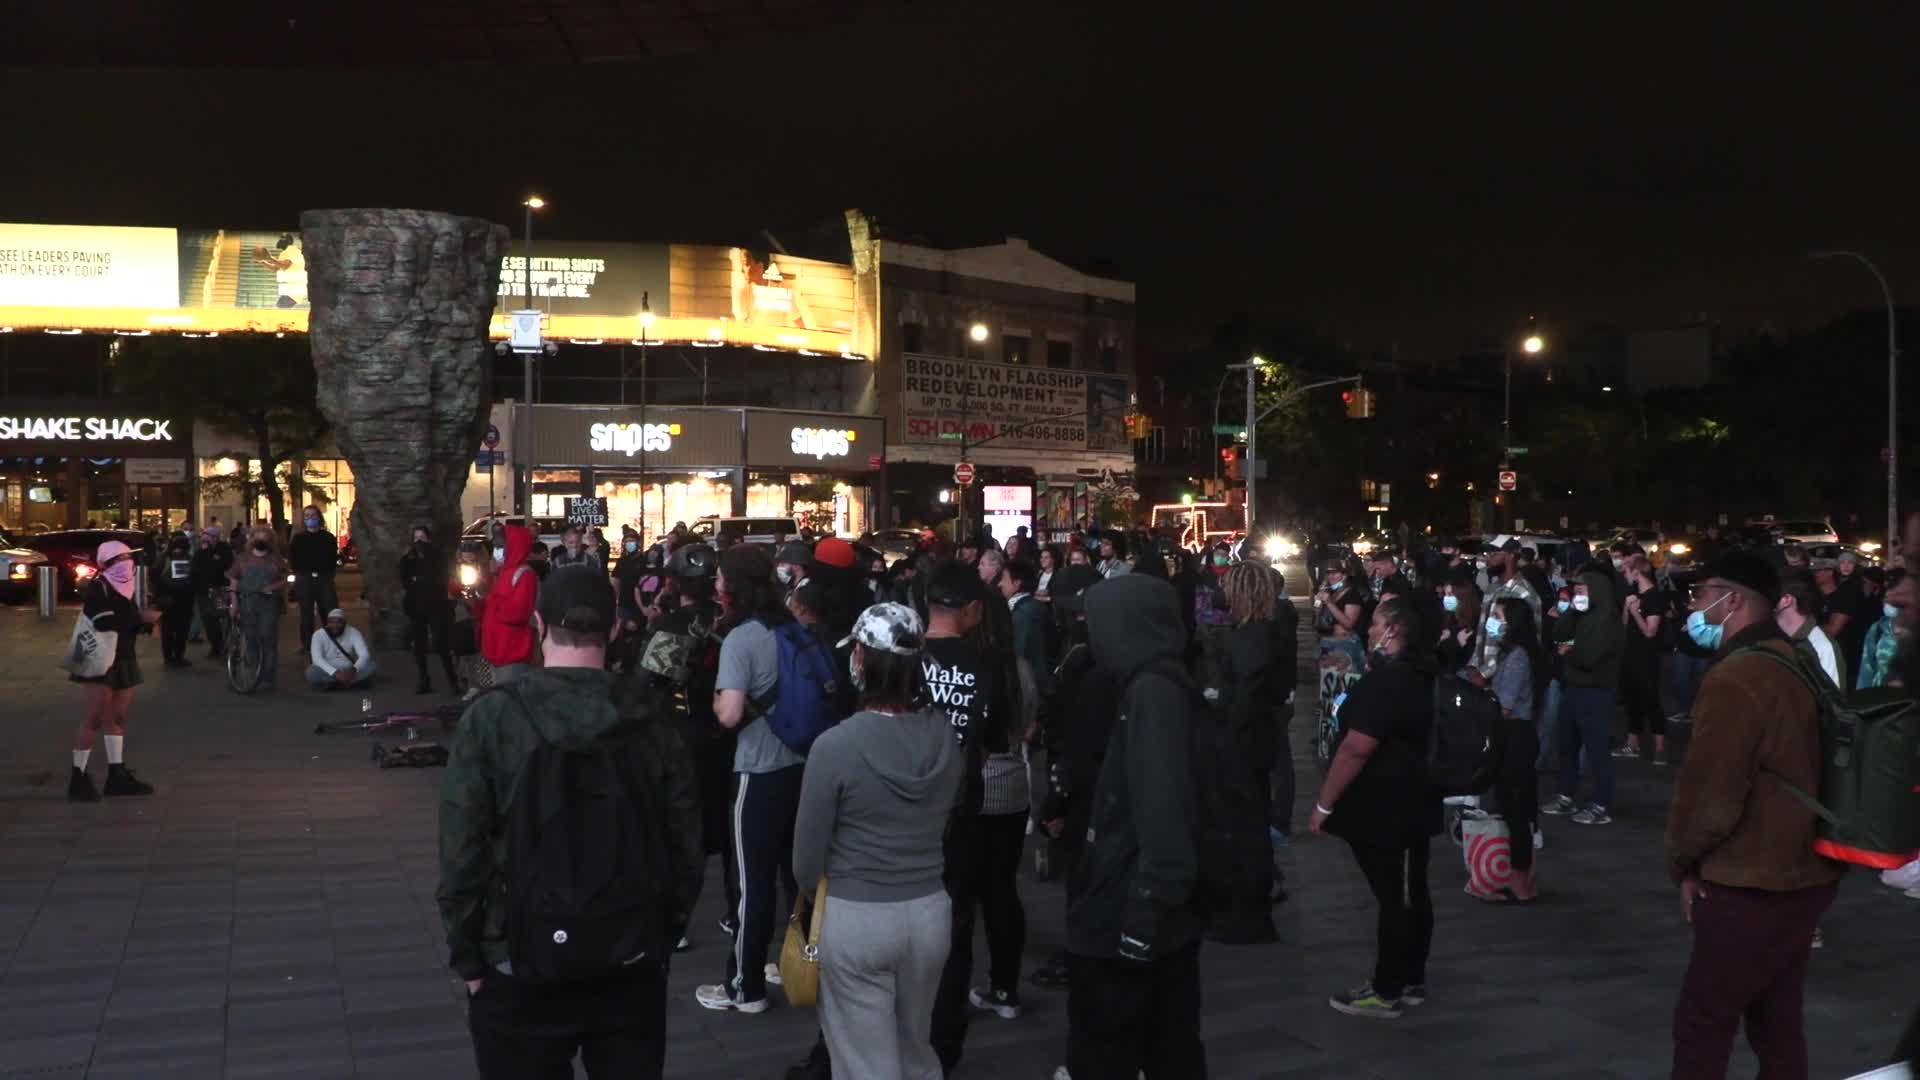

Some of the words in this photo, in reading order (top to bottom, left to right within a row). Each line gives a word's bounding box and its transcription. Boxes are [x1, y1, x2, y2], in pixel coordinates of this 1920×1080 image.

[0, 249, 18, 262] SEE
[22, 250, 70, 263] LEADERS
[73, 252, 111, 264] PAVING
[20, 264, 34, 276] ON
[38, 265, 71, 277] EVERY
[530, 257, 570, 271] HITTING
[571, 258, 605, 272] SHOTS
[563, 271, 596, 285] EVERY
[906, 359, 1000, 382] BROOKLYN
[1007, 369, 1084, 389] FLAGSHIP
[906, 377, 1056, 402] REDEVELOPMENT
[922, 396, 937, 407] UP
[939, 397, 951, 408] TO
[0, 417, 82, 440] SHAKE
[85, 417, 173, 441] SHACK
[571, 498, 600, 507] BLACK
[571, 506, 598, 514] LIVES
[568, 514, 604, 525] MATTER
[921, 661, 975, 687] Make
[926, 682, 975, 707] Wor
